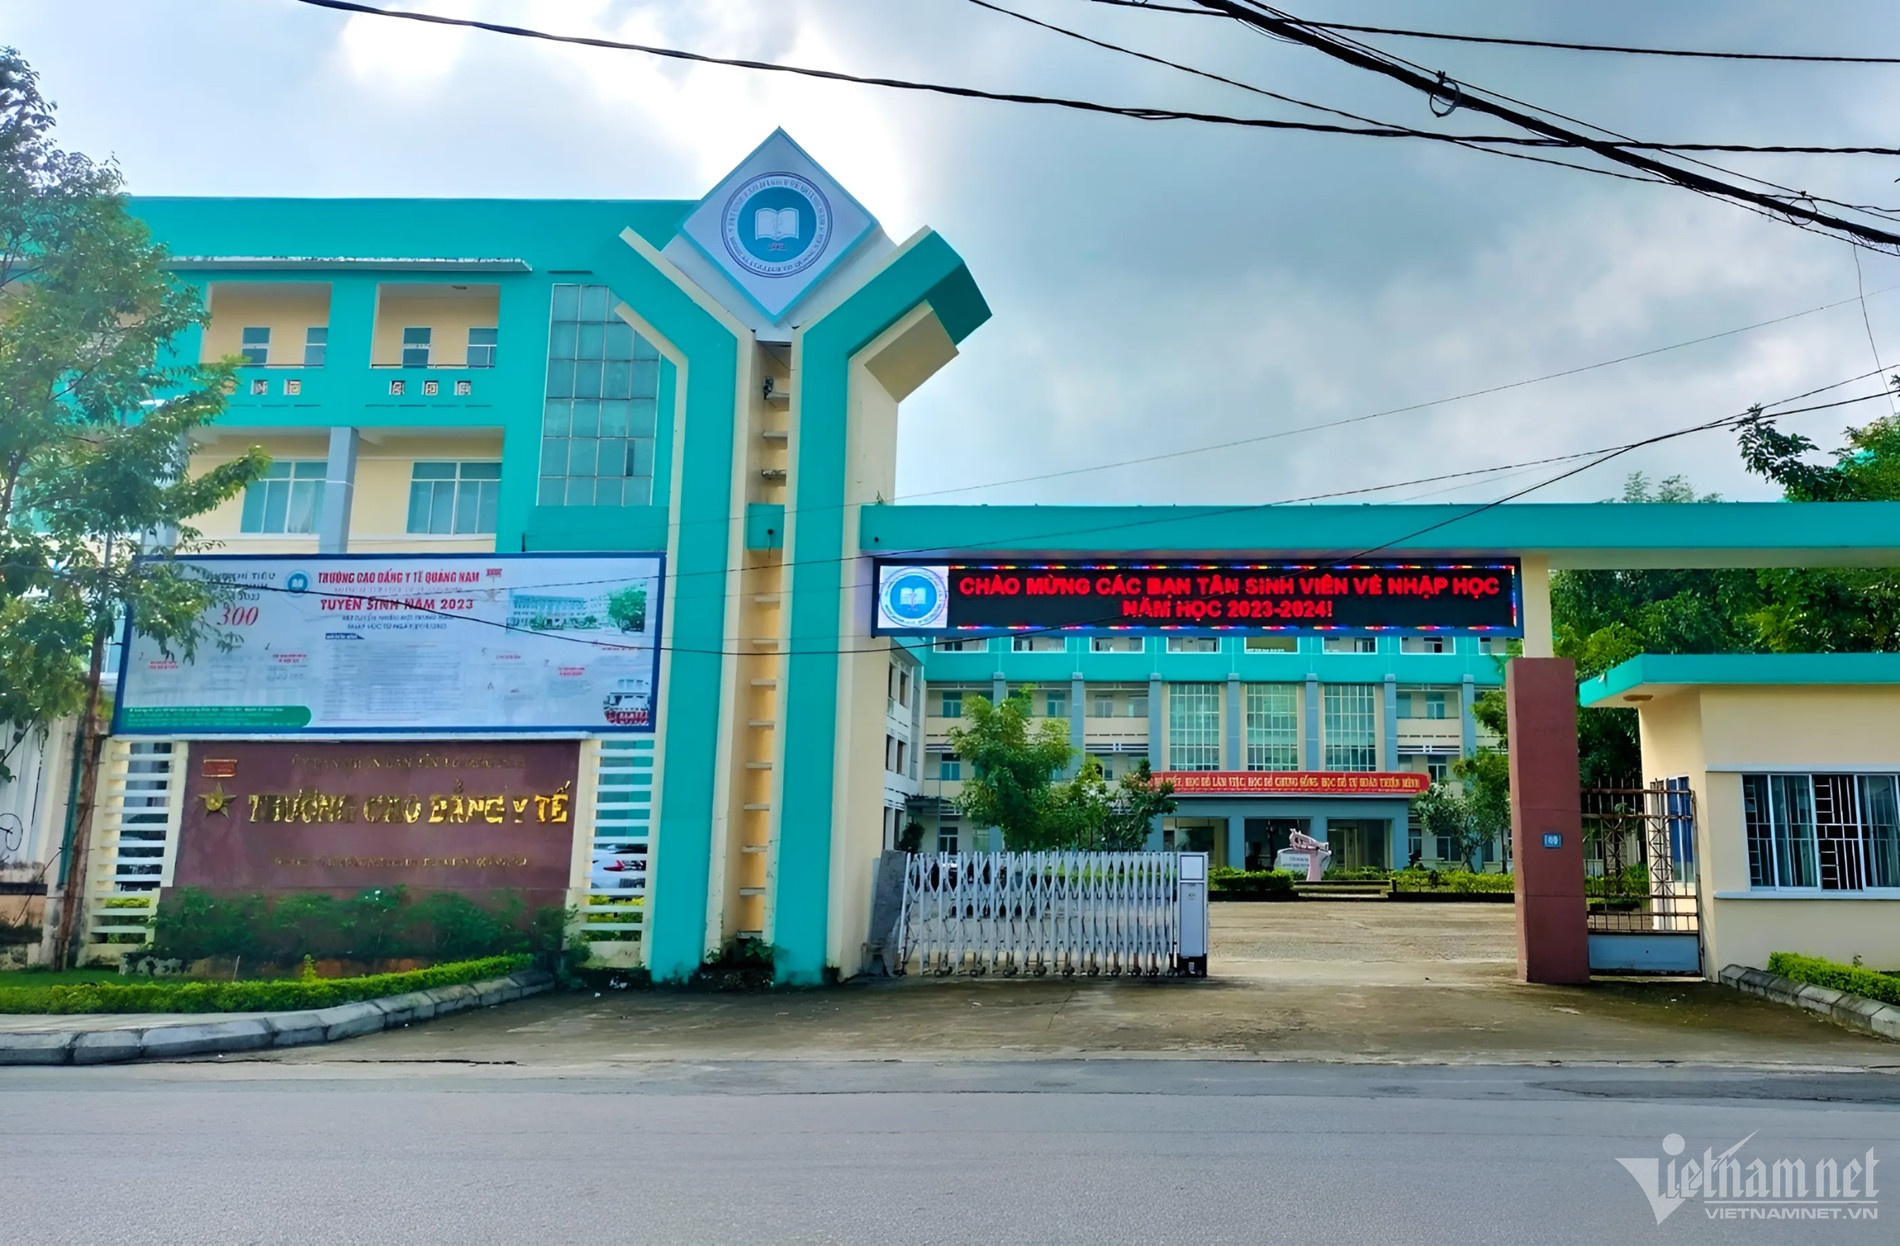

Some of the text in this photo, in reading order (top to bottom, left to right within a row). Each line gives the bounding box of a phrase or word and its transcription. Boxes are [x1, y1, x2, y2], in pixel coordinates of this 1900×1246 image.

[318, 570, 355, 583] TRƯỜNG
[357, 572, 376, 583] CAO
[405, 572, 411, 583] Y
[425, 568, 457, 584] QUẢNG
[459, 571, 480, 583] NAM
[959, 573, 1500, 599] CHÀO MỪNG CÁC BẠN TÂN SINH VIÊN VỀ NHẬP HỌC
[366, 597, 399, 610] SINH
[404, 596, 435, 610] NĂM
[440, 598, 473, 610] 2023
[1122, 596, 1333, 621] NĂM HỌC 2023-2024!
[217, 605, 259, 626] 300
[248, 778, 571, 823] TRƯỜNG CAO ĐẲNG Y TẾ
